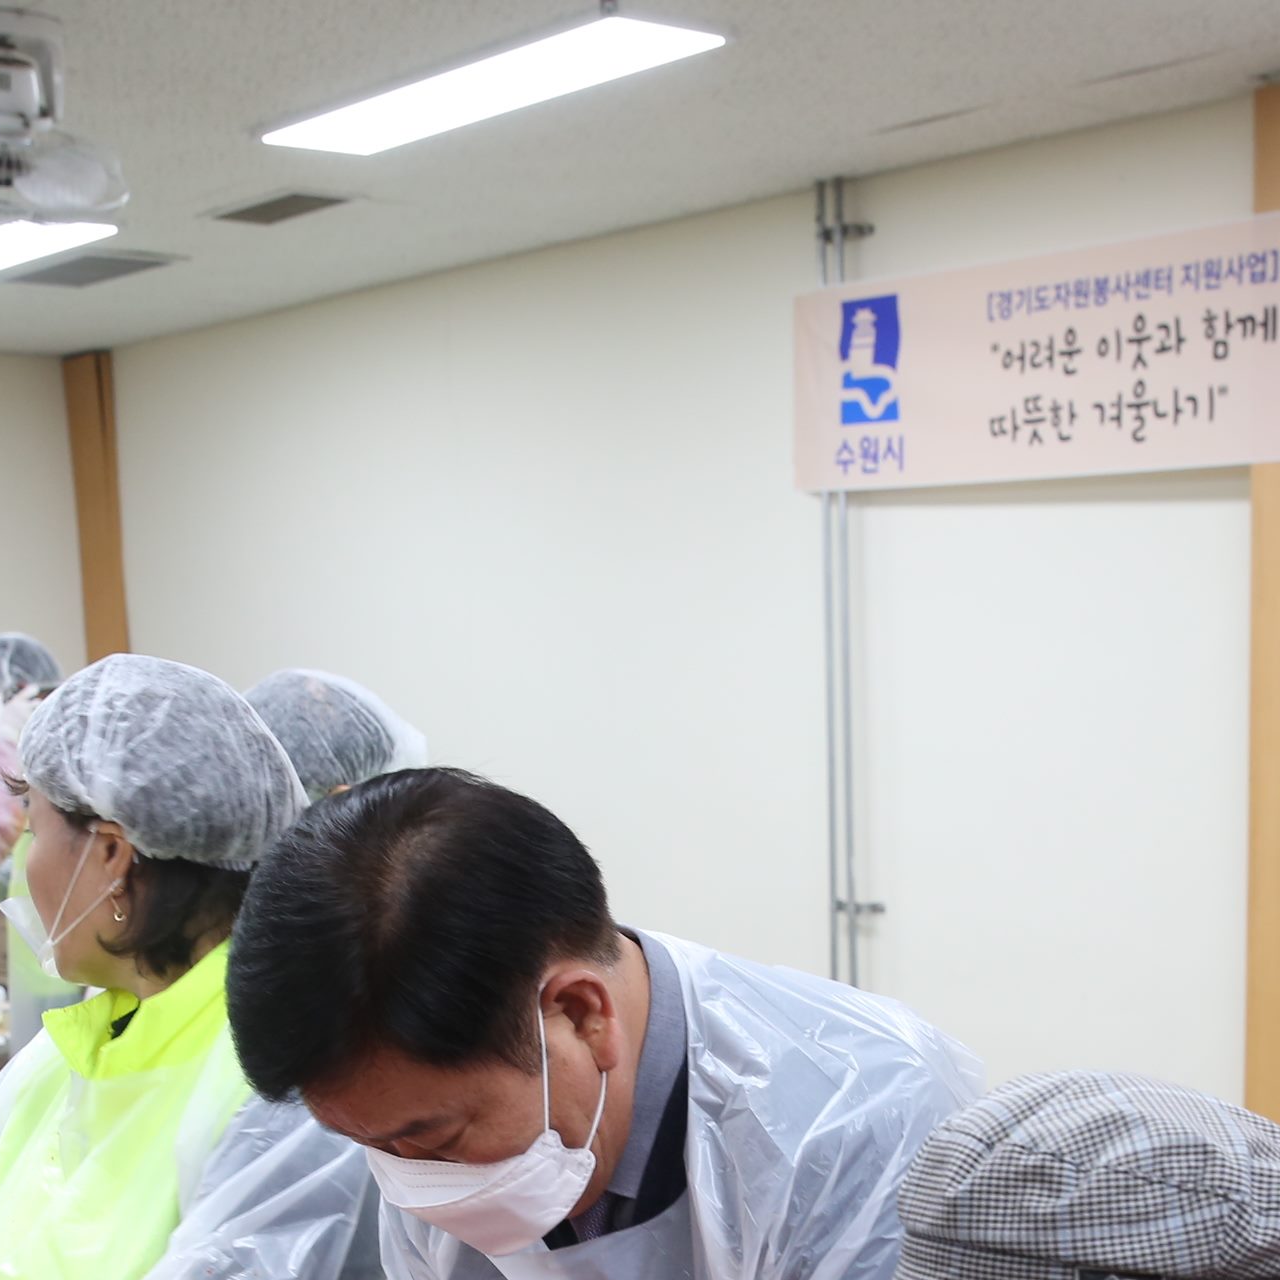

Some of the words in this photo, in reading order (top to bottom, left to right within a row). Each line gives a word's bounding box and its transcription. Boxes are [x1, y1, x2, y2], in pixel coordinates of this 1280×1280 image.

[986, 266, 1173, 322] [경기도자원봉사센터
[1182, 249, 1279, 291] 지원사업]
[990, 326, 1082, 376] "어려운
[1097, 311, 1186, 370] 이웃과
[1202, 305, 1278, 361] 함께
[989, 394, 1077, 446] 따뜻한
[1093, 378, 1228, 443] 겨울나기"
[835, 432, 905, 475] 수원시
